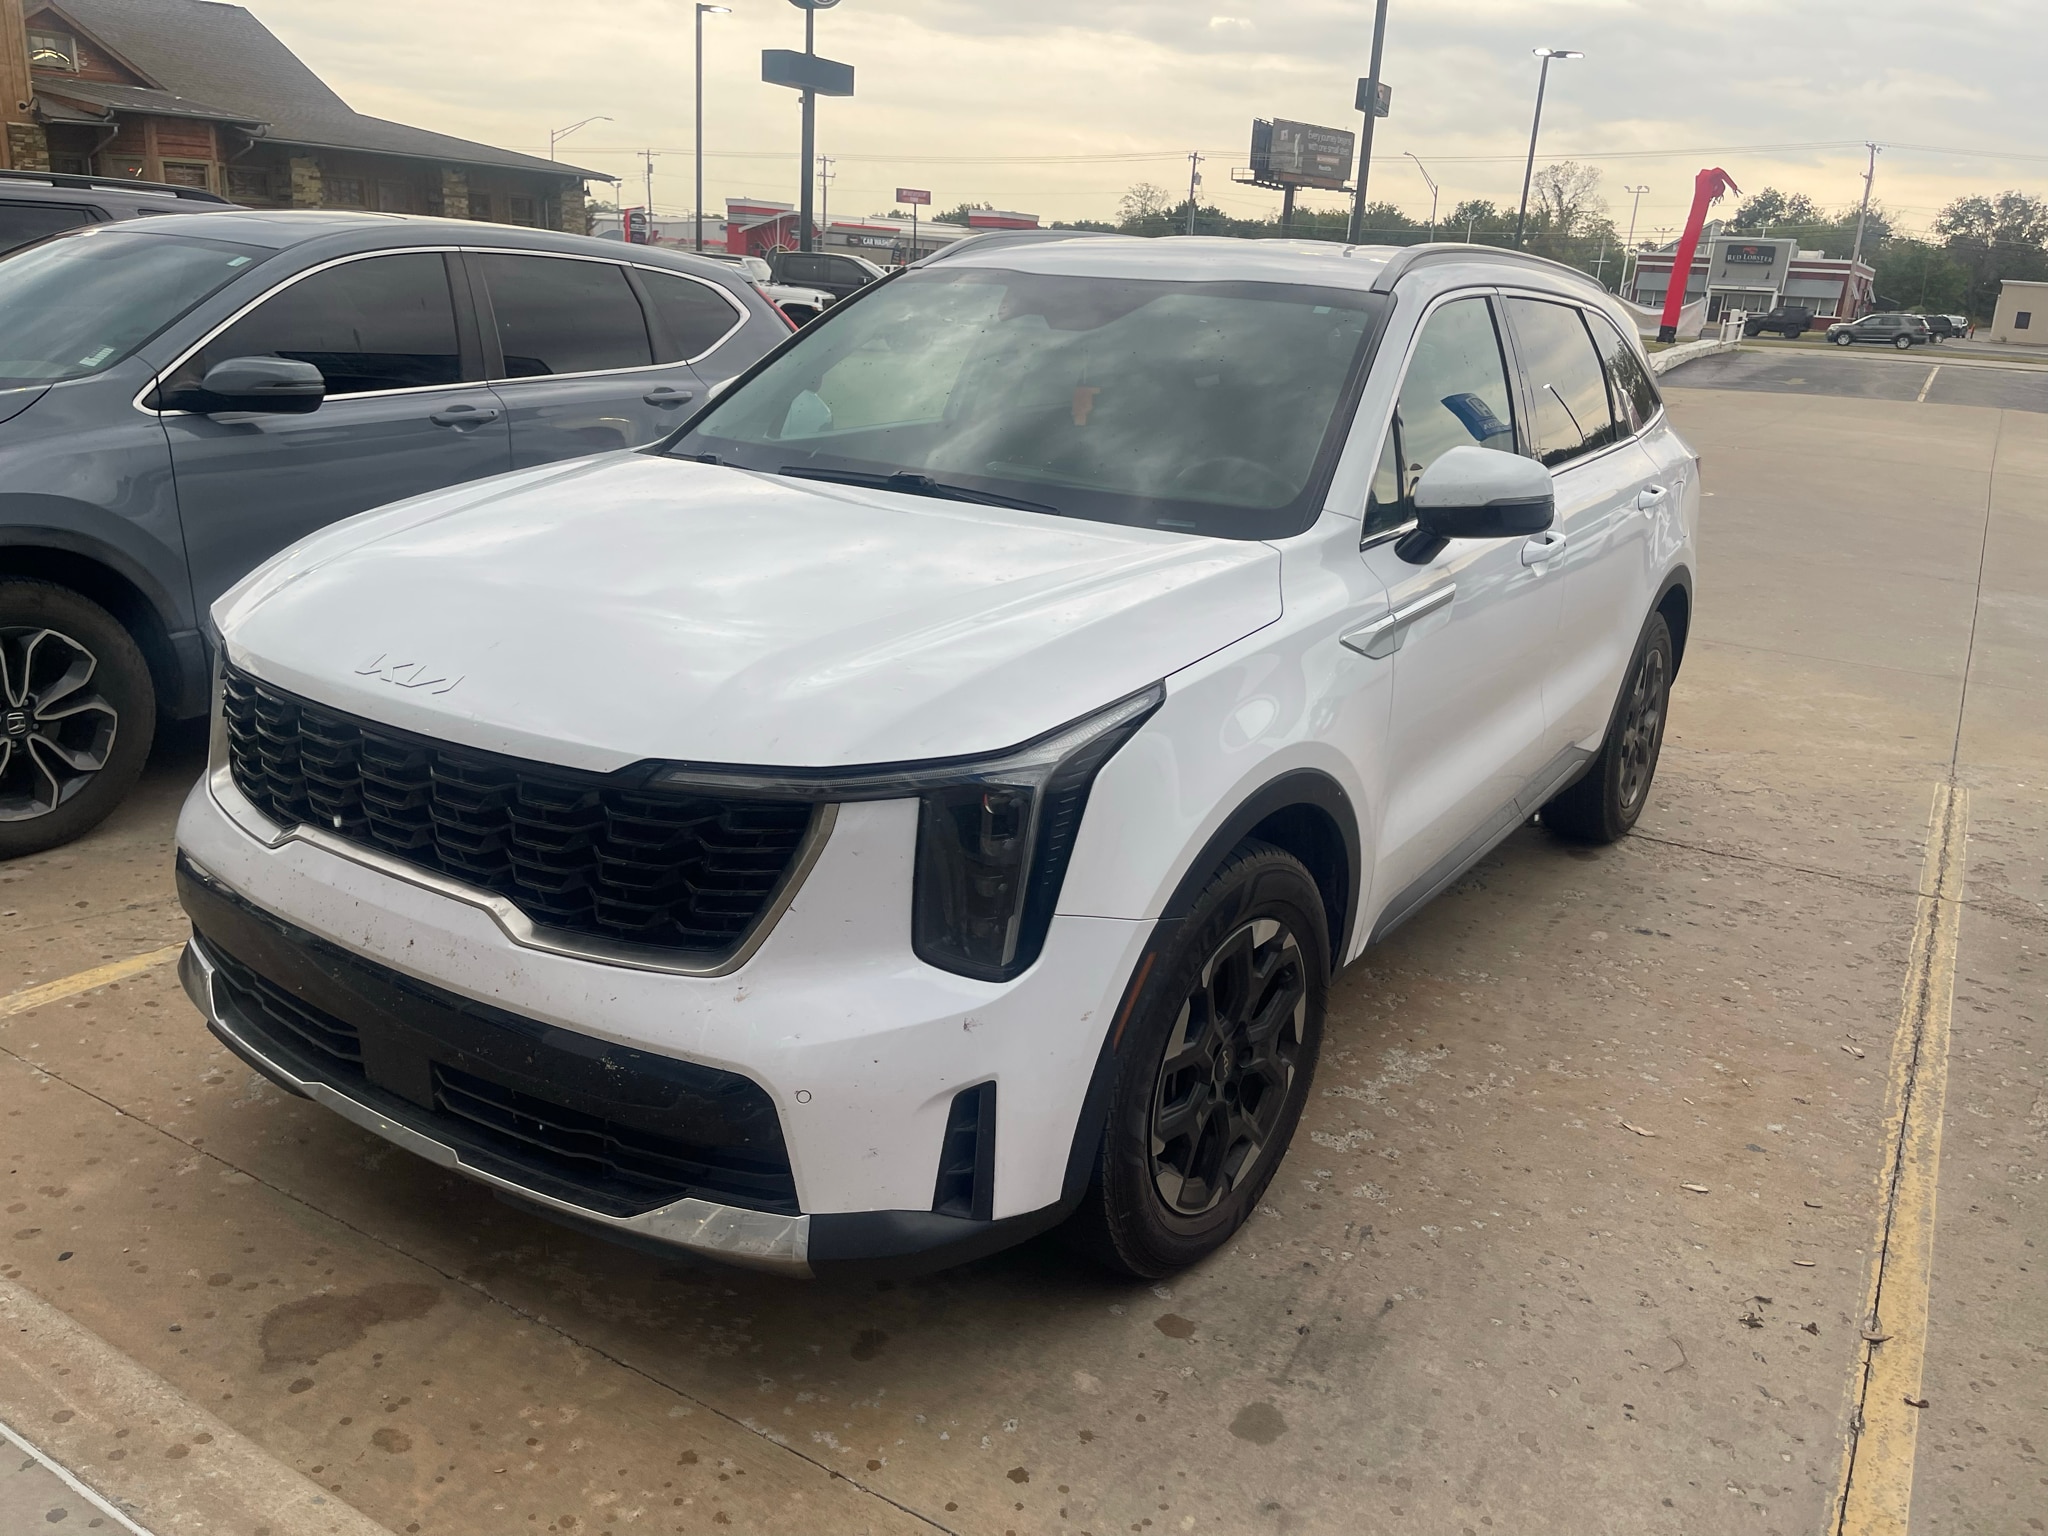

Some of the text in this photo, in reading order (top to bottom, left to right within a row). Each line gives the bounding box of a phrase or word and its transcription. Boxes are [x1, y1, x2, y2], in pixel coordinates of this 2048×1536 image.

[1308, 130, 1320, 142] Every
[1320, 134, 1337, 145] journey
[863, 237, 873, 245] CAR
[1743, 254, 1773, 263] LOBSTER
[354, 652, 466, 695] KIA
